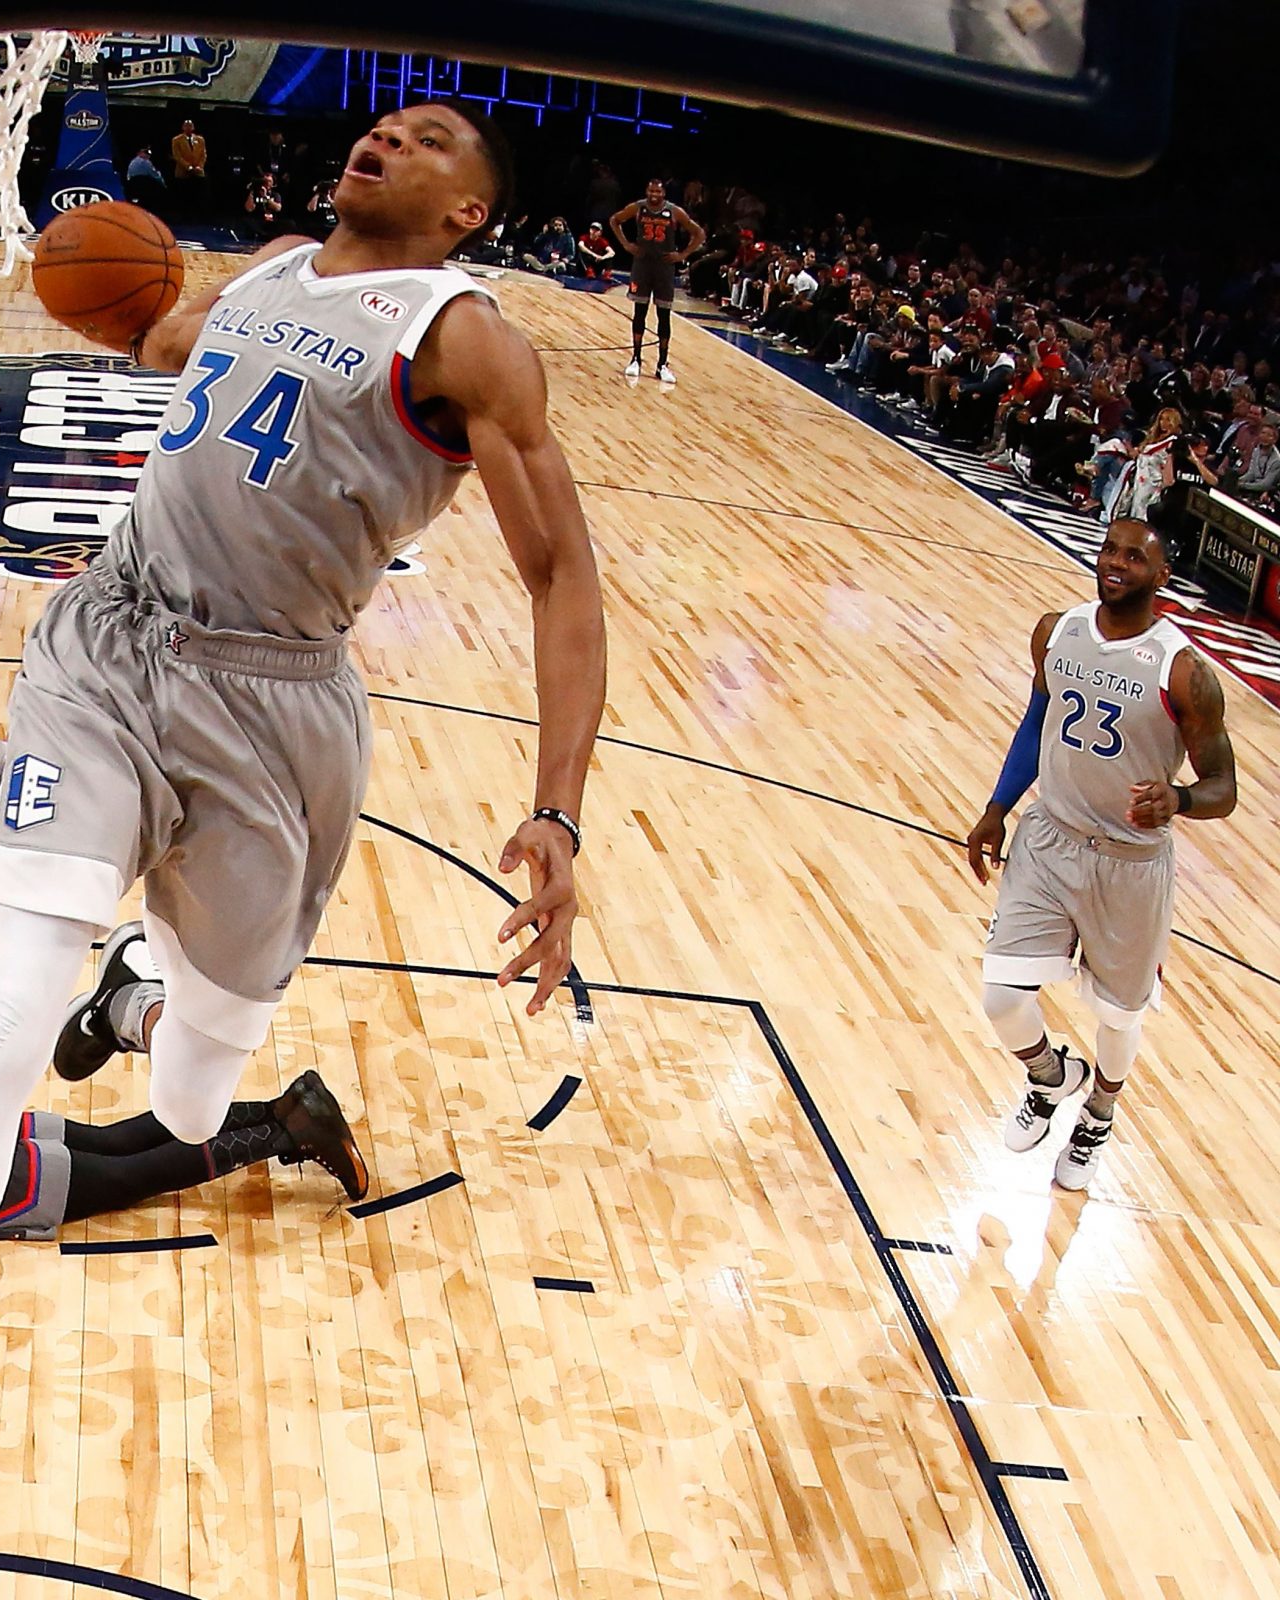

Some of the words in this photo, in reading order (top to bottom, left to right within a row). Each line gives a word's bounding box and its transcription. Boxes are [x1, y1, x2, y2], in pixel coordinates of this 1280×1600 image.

[62, 193, 101, 209] KIA
[368, 296, 400, 320] KIA
[158, 348, 302, 489] 34
[1206, 535, 1223, 560] ALL
[1230, 550, 1256, 578] STAR
[1136, 650, 1155, 663] KIA
[1060, 688, 1125, 760] 23
